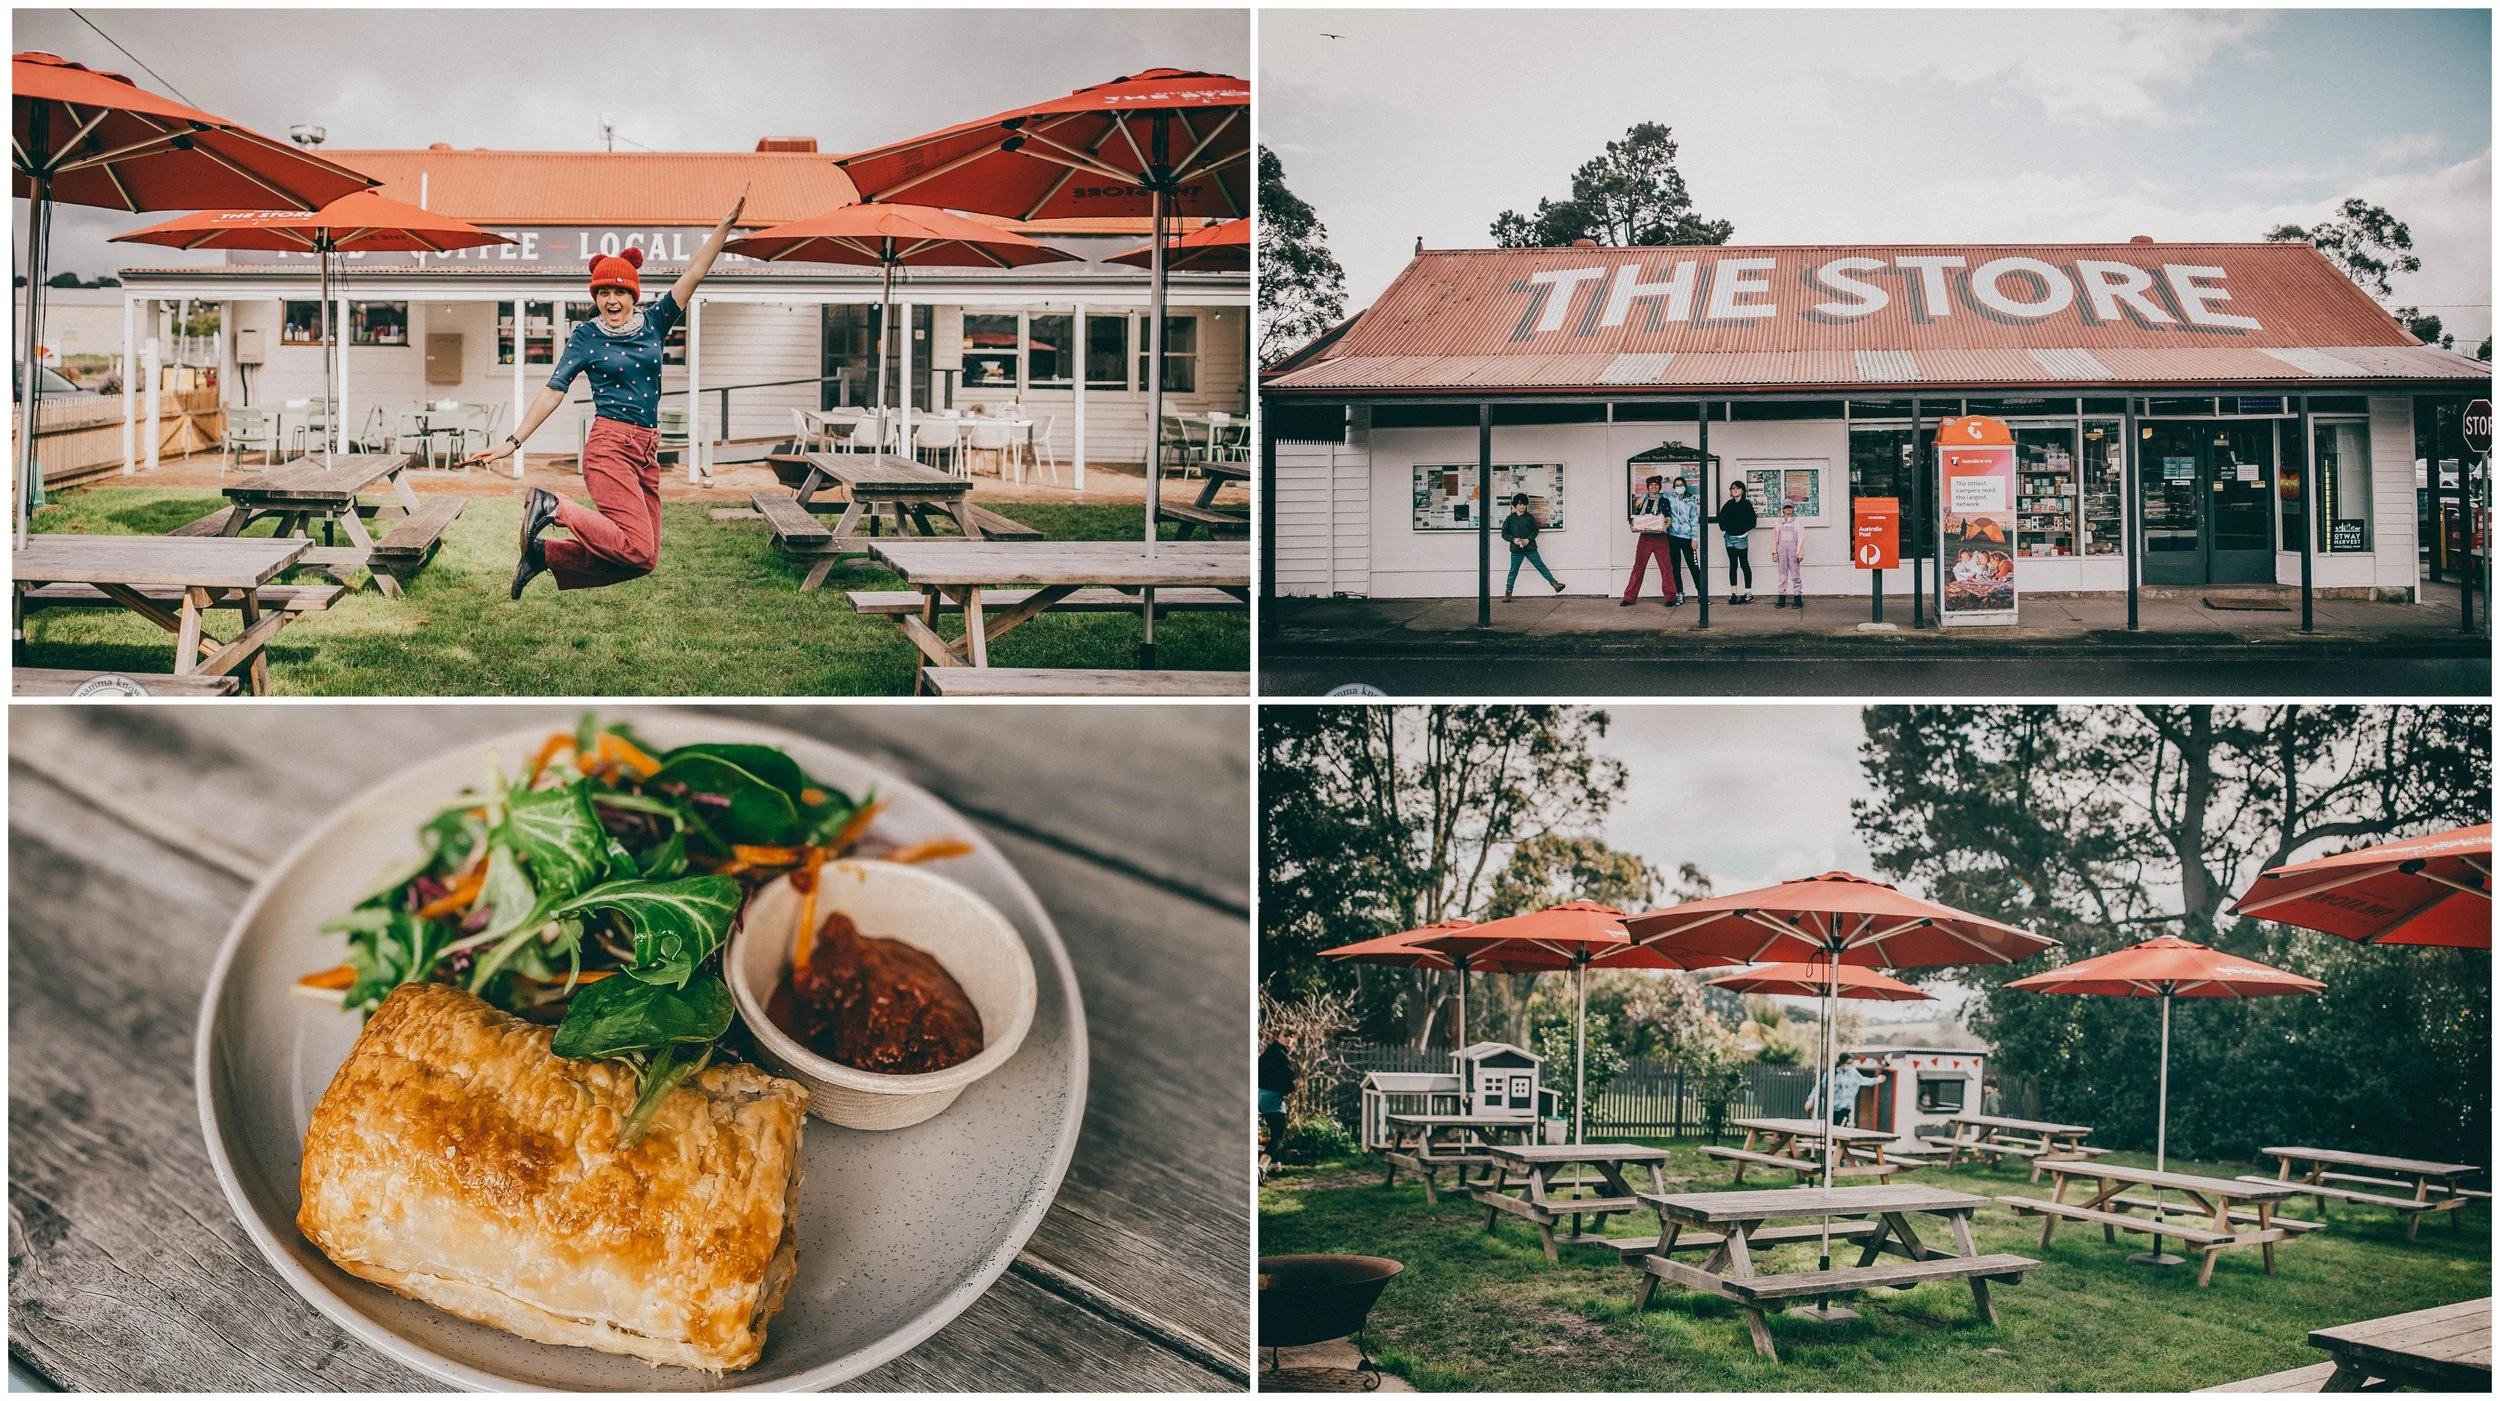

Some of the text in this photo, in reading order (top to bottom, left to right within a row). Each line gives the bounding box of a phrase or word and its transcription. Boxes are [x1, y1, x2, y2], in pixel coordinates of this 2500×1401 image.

[579, 232, 690, 261] LOCAL
[1530, 255, 2263, 332] THE STORE
